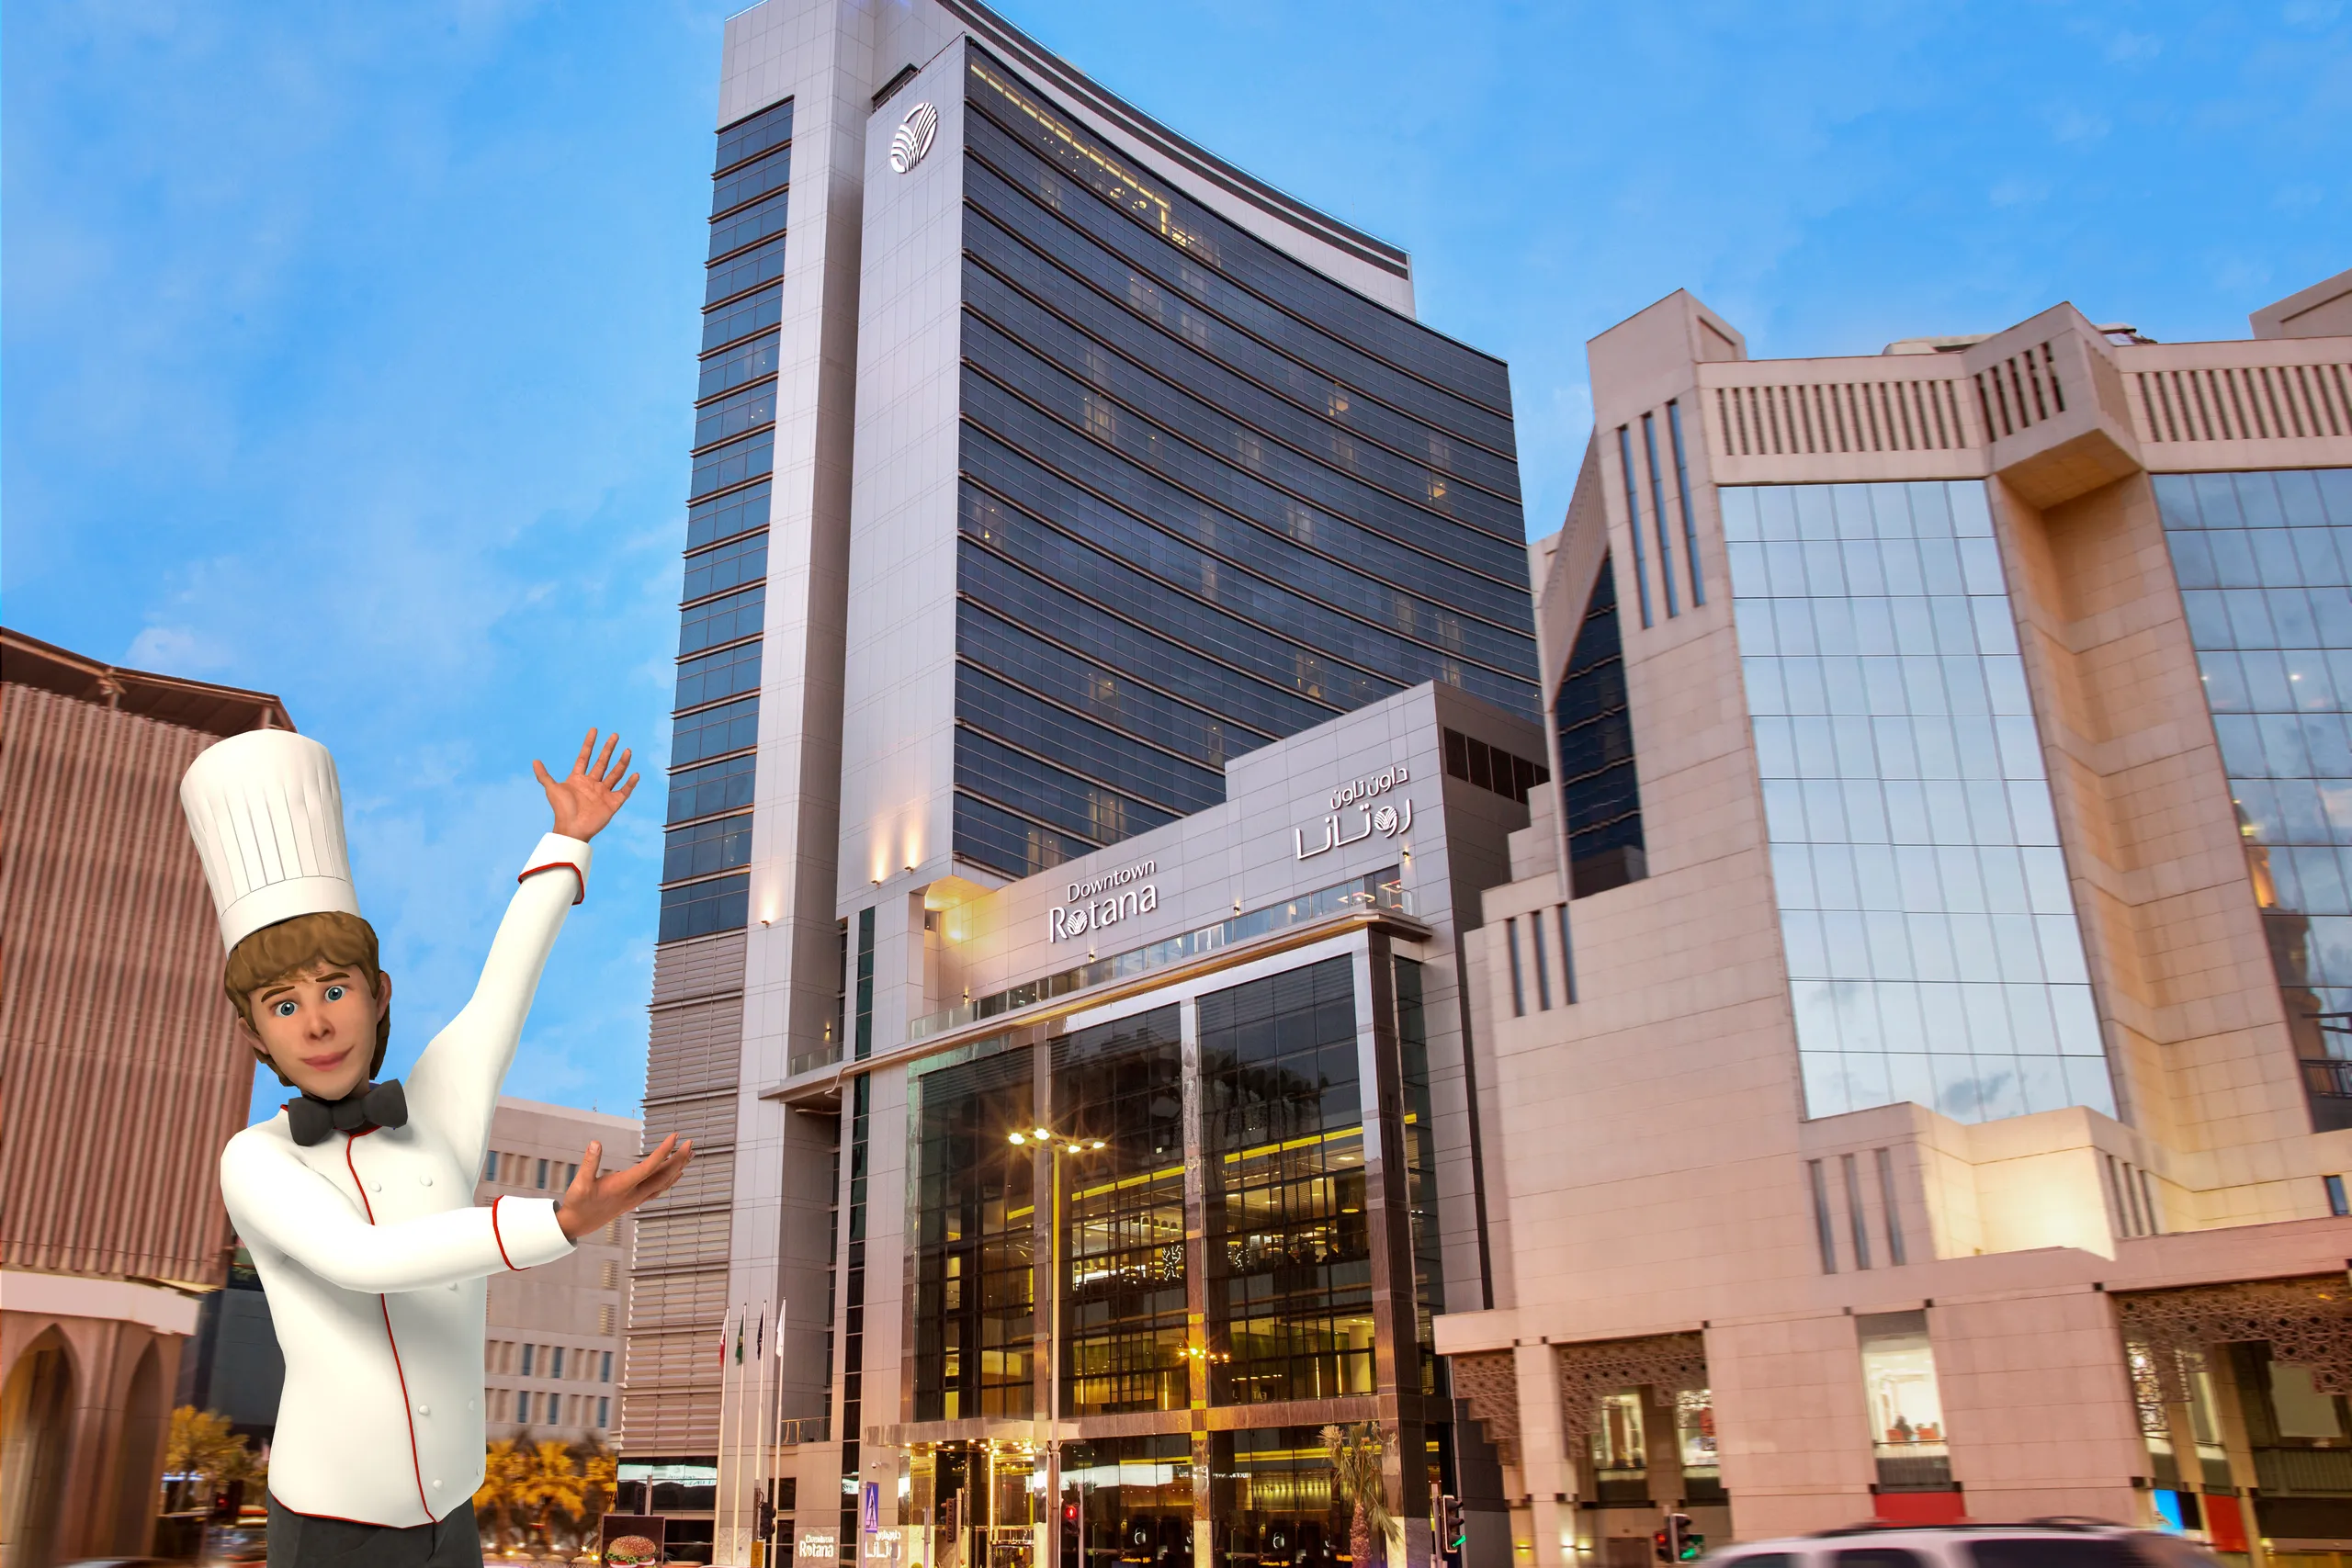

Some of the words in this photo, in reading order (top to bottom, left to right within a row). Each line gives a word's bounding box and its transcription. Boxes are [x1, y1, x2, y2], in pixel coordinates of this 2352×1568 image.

[1330, 780, 1366, 810] تاون
[1367, 766, 1408, 797] داون
[1295, 798, 1412, 860] روتانا
[1068, 860, 1156, 903] Downtown
[1049, 885, 1158, 943] Rotana
[799, 1540, 834, 1558] Rotana
